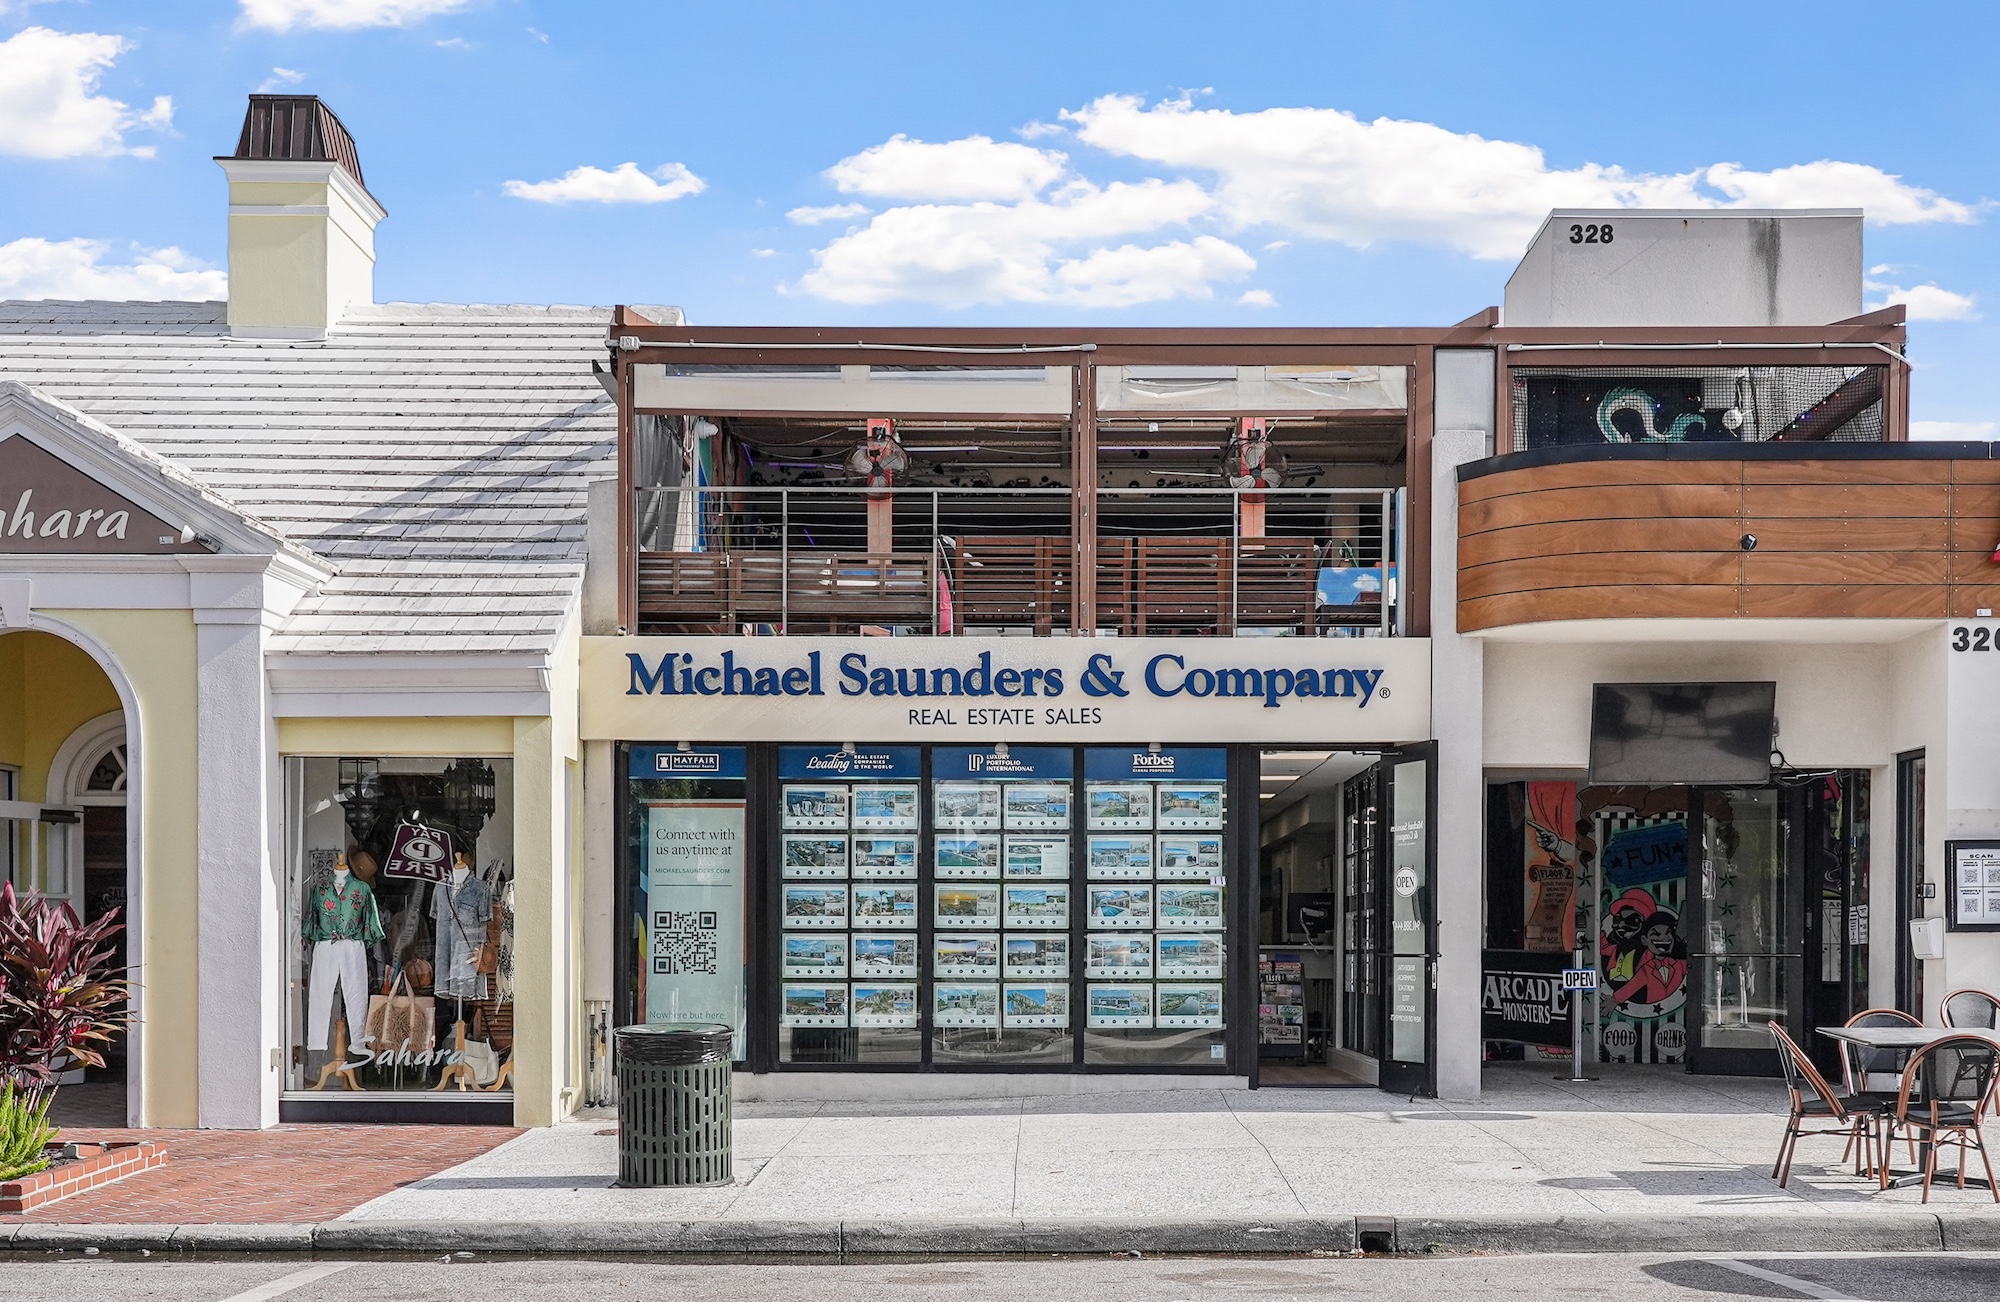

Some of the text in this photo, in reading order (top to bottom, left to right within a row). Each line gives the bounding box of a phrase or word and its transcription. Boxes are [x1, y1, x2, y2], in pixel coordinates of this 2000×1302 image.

[1569, 224, 1614, 244] 328
[0, 488, 130, 540] hara
[625, 650, 825, 697] Michael
[838, 651, 1063, 698] Saunders
[1080, 653, 1130, 698] &
[908, 708, 1102, 726] REAL ESTATE SALES
[673, 756, 715, 764] MAYFAIR
[806, 751, 850, 773] Leading
[1132, 753, 1175, 766] Forbes
[656, 828, 735, 840] Connect with
[656, 844, 733, 859] us anytime at
[1625, 842, 1672, 870] FUN
[1540, 867, 1572, 879] FLOOR 2
[1396, 876, 1415, 888] OPEN
[1566, 972, 1594, 986] OPEN
[1481, 976, 1569, 1014] ARCADE
[649, 1011, 688, 1019] Nowhere
[690, 1011, 703, 1019] but
[1503, 1002, 1551, 1024] MONSTERS
[1605, 1030, 1636, 1046] FOOD
[337, 1036, 465, 1071] Sahara
